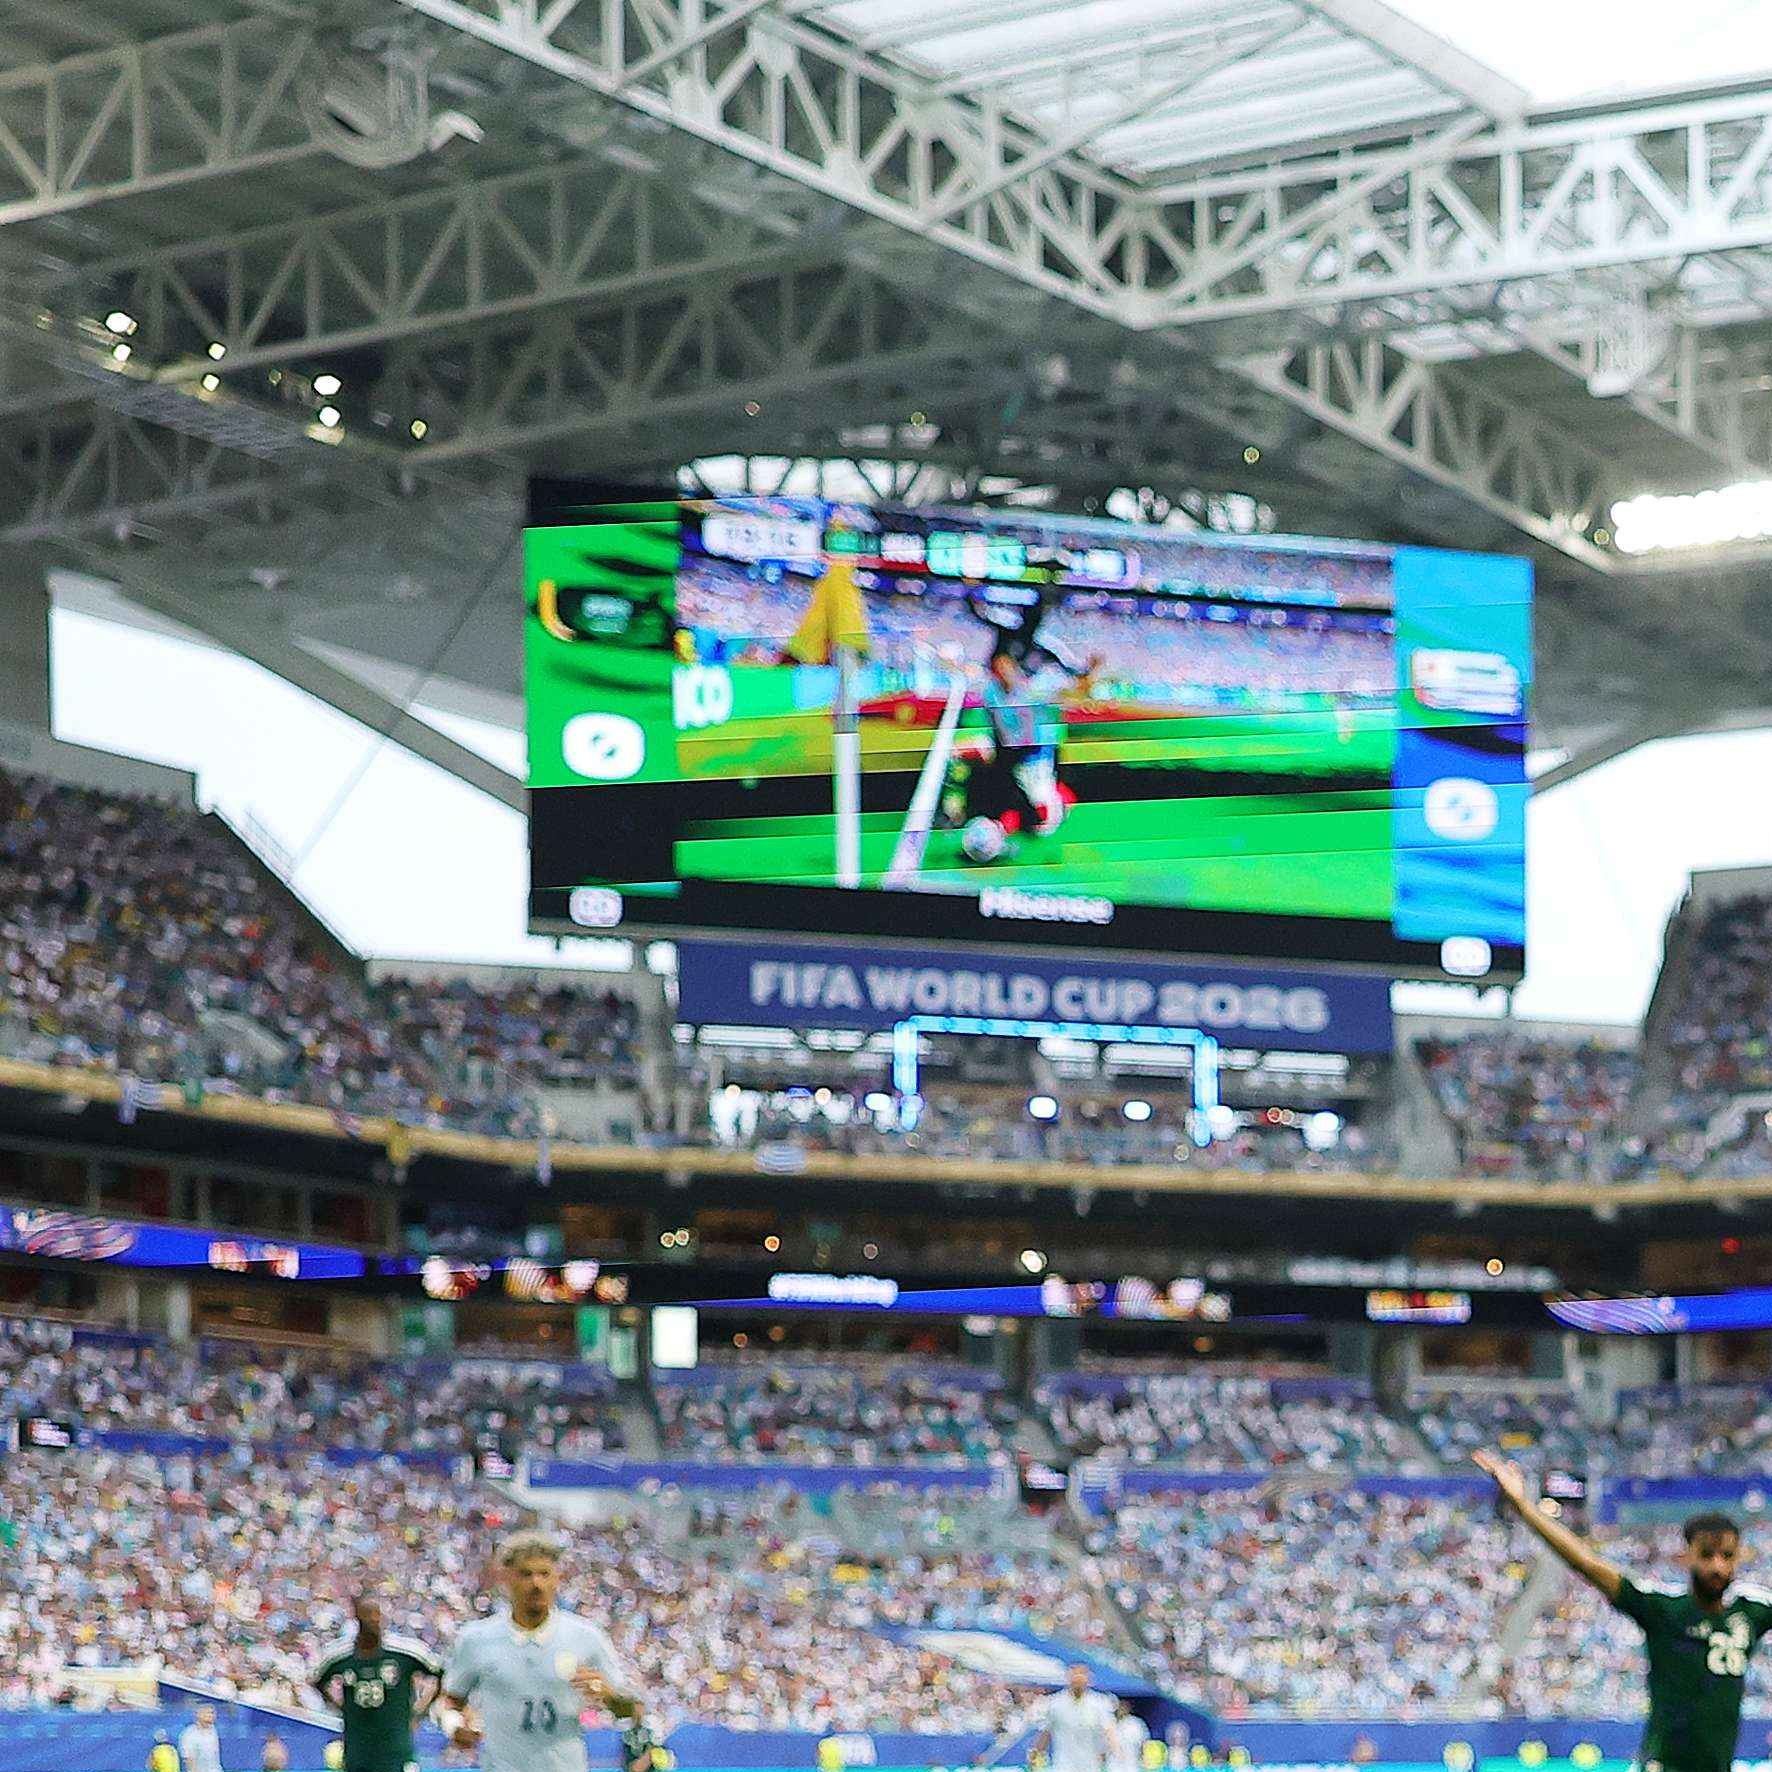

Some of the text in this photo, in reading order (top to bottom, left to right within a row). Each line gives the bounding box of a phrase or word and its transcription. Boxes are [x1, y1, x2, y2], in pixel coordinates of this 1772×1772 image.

[751, 960, 1329, 1033] FIFA WORLD CUP 2026
